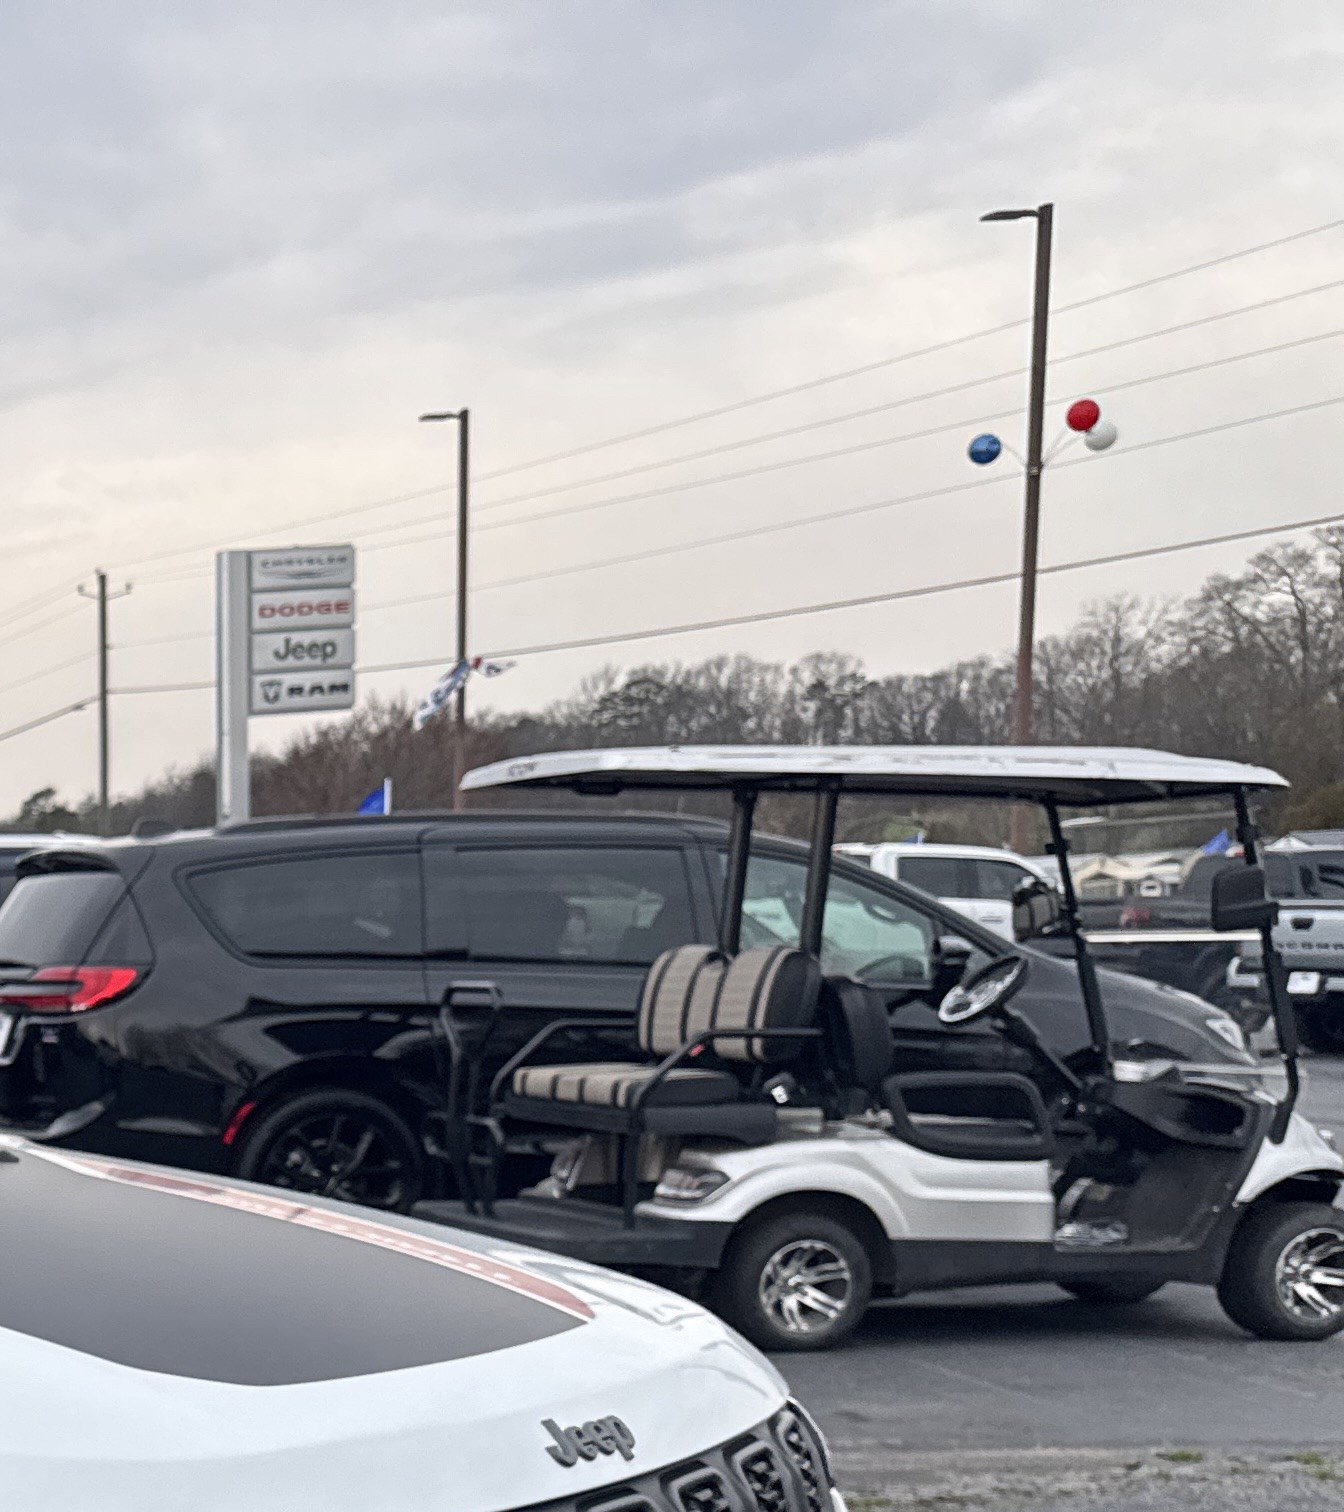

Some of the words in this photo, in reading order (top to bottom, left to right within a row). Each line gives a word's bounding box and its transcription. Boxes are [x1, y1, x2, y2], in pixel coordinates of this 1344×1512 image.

[258, 601, 351, 618] DODGE
[273, 637, 337, 663] Jeep
[287, 682, 349, 697] RAM
[540, 1414, 636, 1468] Jeep
